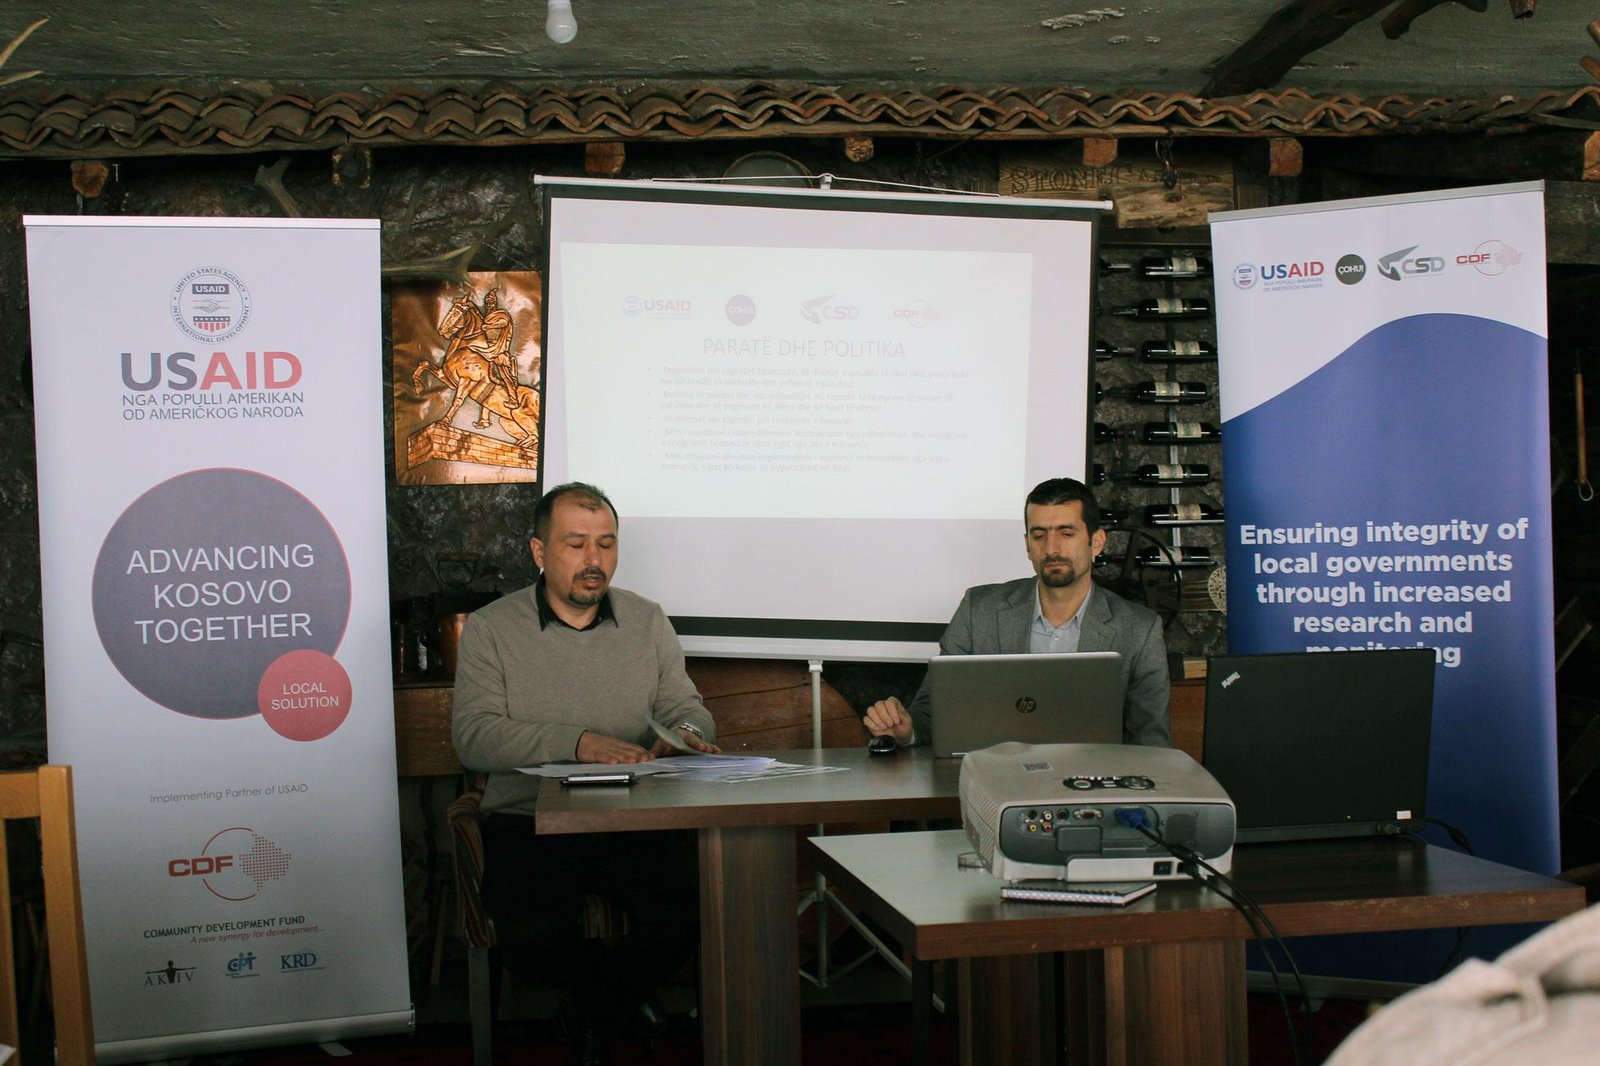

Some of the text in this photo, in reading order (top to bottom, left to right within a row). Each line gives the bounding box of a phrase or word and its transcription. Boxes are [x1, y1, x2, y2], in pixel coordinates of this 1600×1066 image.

[1402, 256, 1446, 274] CSD
[1456, 253, 1491, 265] CDF
[175, 267, 246, 293] UNITED STATES AGENCY
[1261, 261, 1325, 280] USAID
[195, 285, 226, 293] USAID
[644, 298, 692, 312] USAID
[172, 305, 250, 343] INTERNATIONAL DEVELOPMENT
[703, 335, 907, 359] PARATË DHE POLITIKA
[121, 351, 303, 391] USAID
[122, 391, 304, 406] NGA POPULLI AMERIKAN
[123, 405, 304, 420] OD AMERIČKOG NARODA
[1240, 517, 1529, 547] Ensuring integrity of
[126, 543, 315, 575] ADVANCING
[1254, 550, 1513, 577] local governments
[154, 579, 292, 609] KOSOVO
[1256, 580, 1511, 607] through increased
[134, 612, 313, 644] TOGETHER
[1293, 611, 1473, 633] research and
[283, 682, 327, 695] LOCAL
[271, 696, 339, 710] SOLUTION
[150, 784, 308, 803] Implementing Partner of USAID
[168, 855, 233, 877] CDF
[143, 915, 305, 939] COMMUNITY DEVELOPMENT FUND
[190, 936, 197, 944] A
[198, 935, 216, 944] new
[218, 932, 251, 943] synergy
[252, 930, 265, 939] for
[280, 951, 317, 970] KRD
